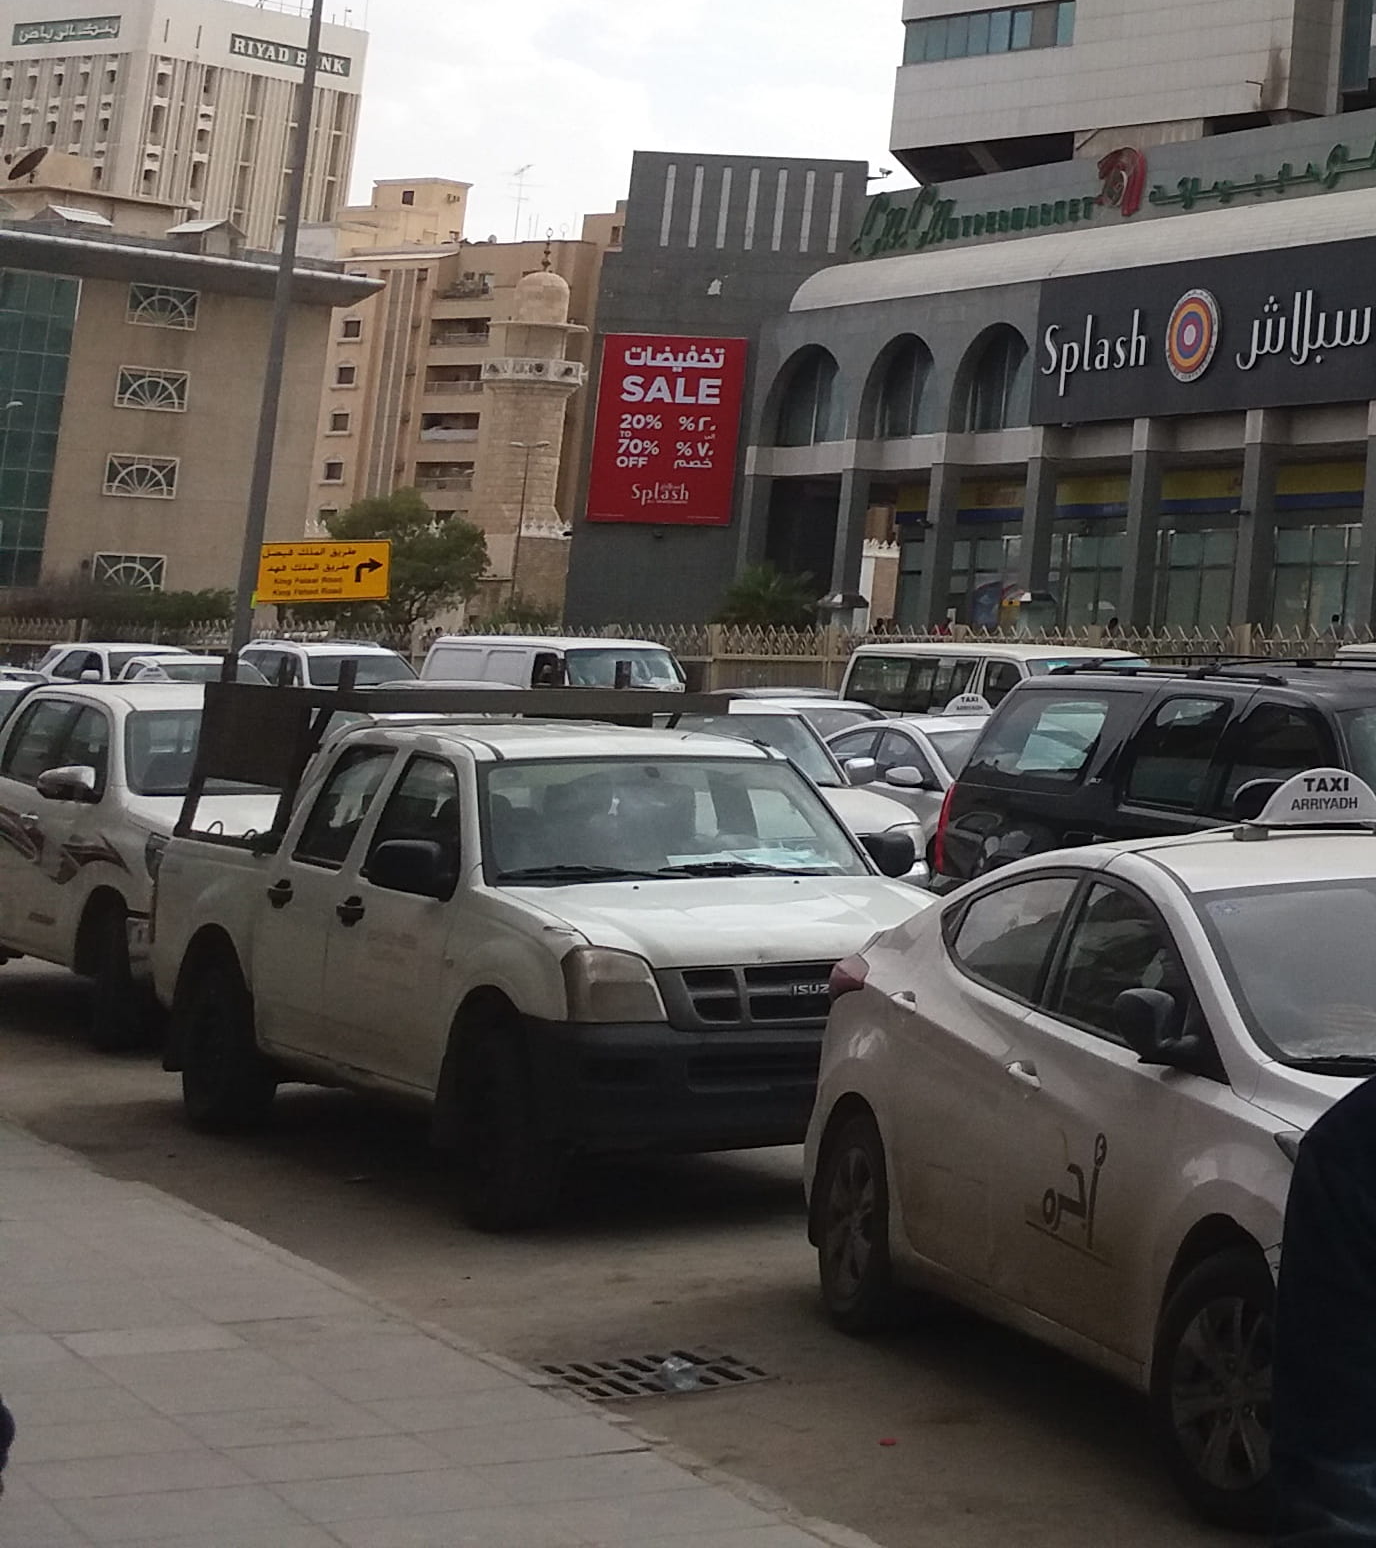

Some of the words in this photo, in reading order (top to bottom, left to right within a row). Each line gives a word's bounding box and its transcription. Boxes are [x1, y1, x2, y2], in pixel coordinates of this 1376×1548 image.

[234, 37, 290, 63] RIYAD
[297, 49, 345, 75] BNK
[1236, 289, 1372, 371] سبلاش
[624, 345, 726, 373] تخفيضات
[1041, 308, 1148, 397] Splash
[620, 375, 722, 405] SALE
[619, 414, 663, 430] 20%
[620, 430, 632, 438] TO
[617, 438, 660, 455] 70%
[616, 456, 649, 469] OFF
[673, 458, 713, 469] خصم
[631, 482, 690, 506] Splash
[1303, 777, 1350, 792] TAXI
[1290, 797, 1358, 811] ARRIYADH
[793, 983, 830, 996] ISUZ
